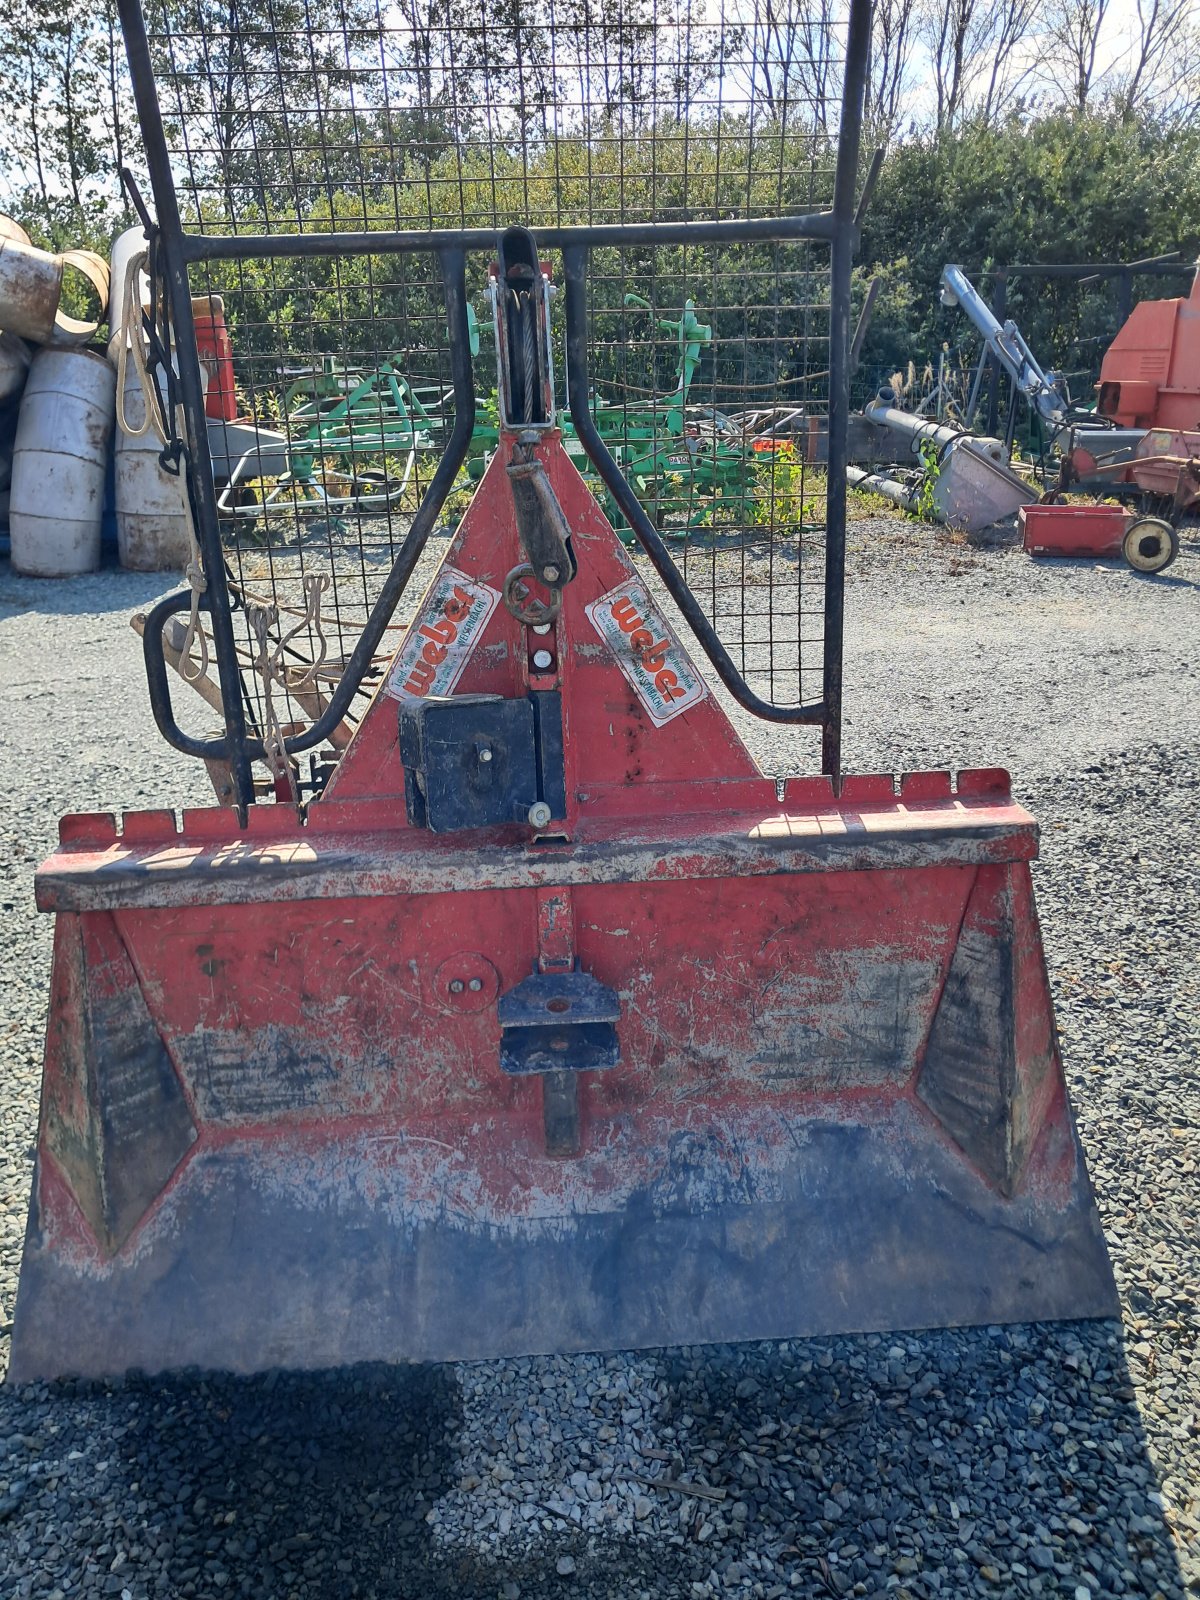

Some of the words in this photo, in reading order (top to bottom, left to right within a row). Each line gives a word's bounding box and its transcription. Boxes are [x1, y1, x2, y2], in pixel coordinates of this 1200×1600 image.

[403, 585, 476, 697] weber
[410, 633, 426, 650] und
[610, 595, 688, 704] weber
[651, 625, 665, 641] und
